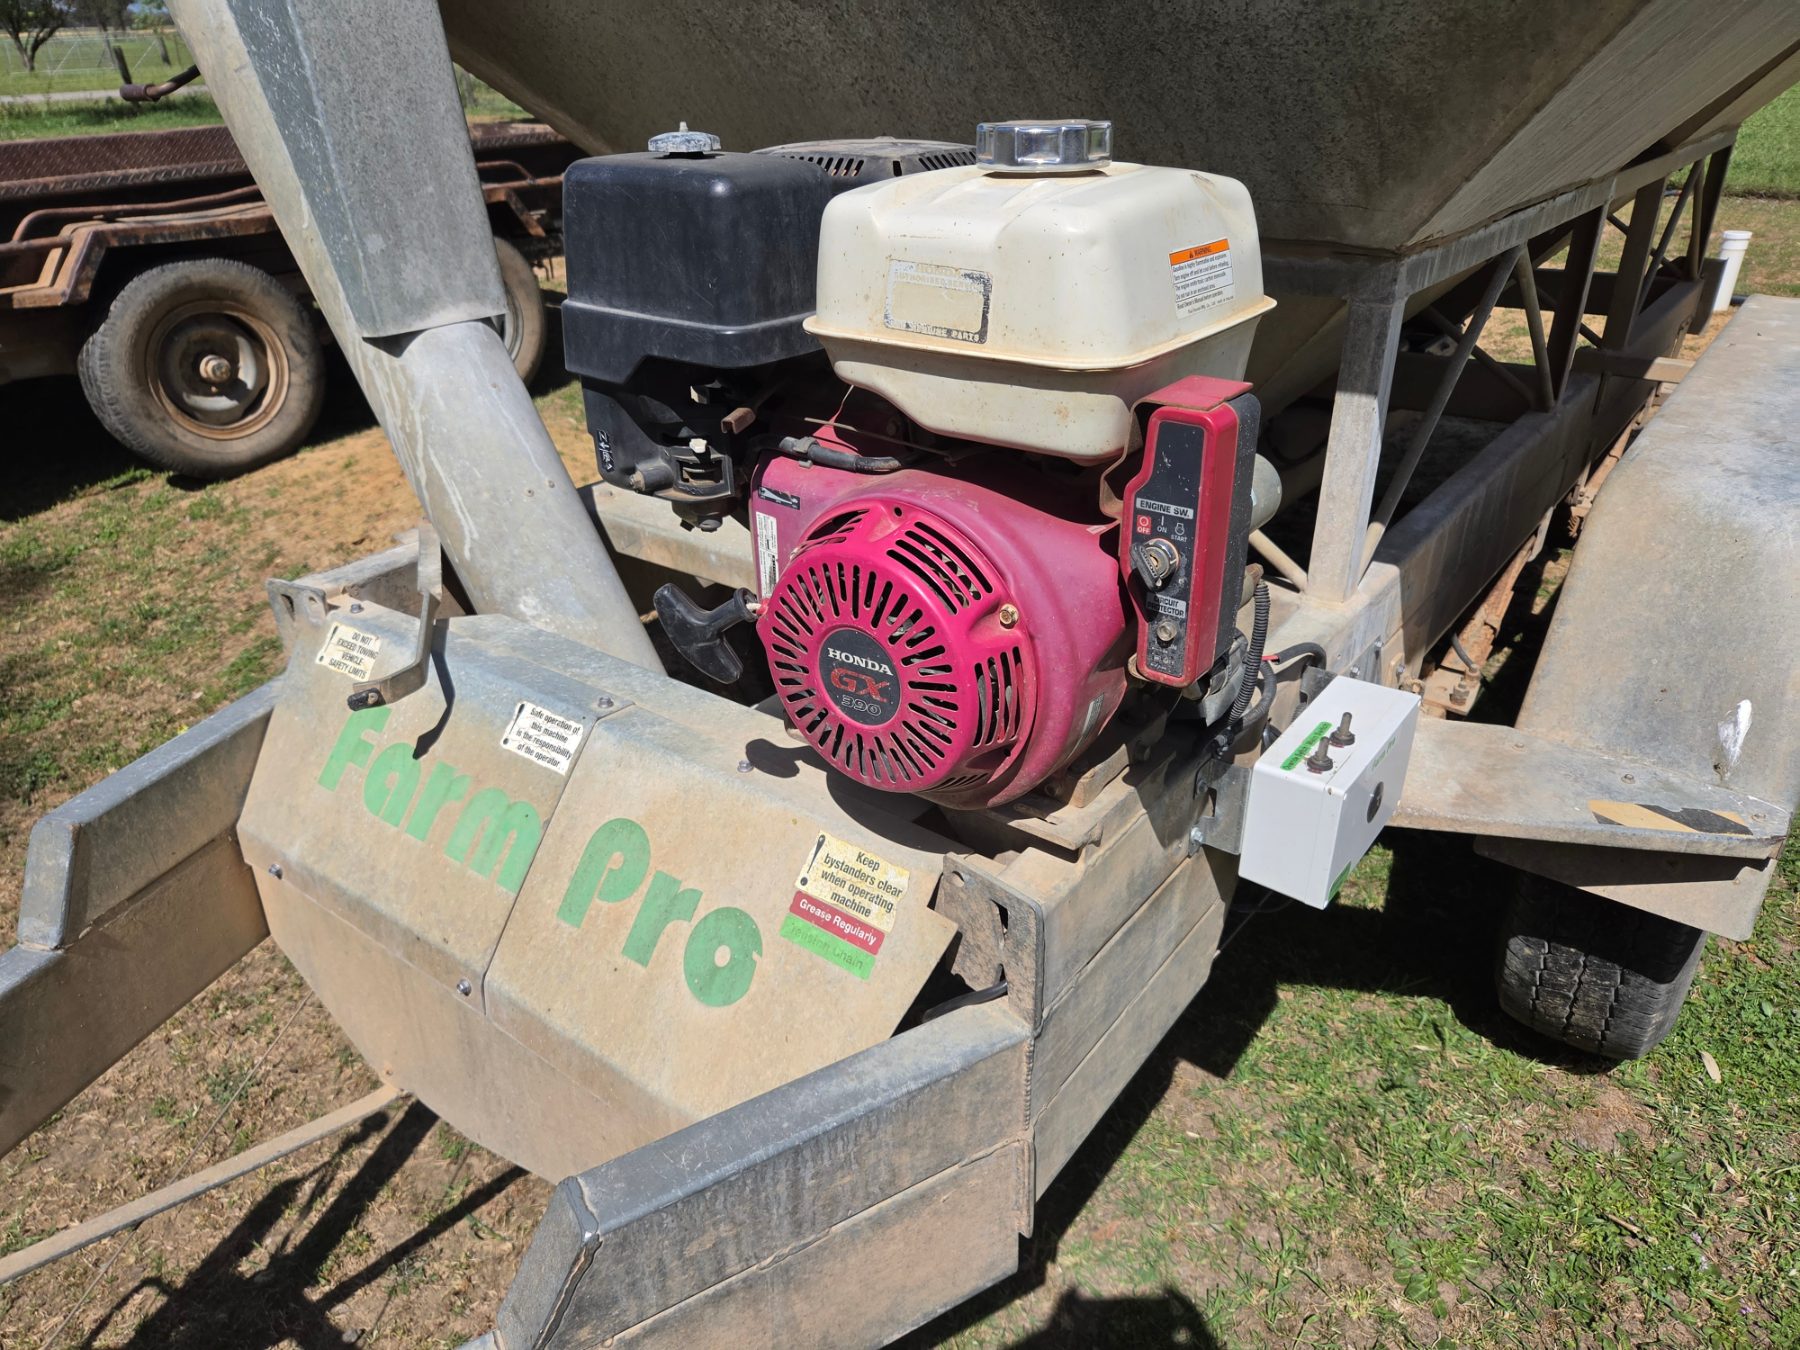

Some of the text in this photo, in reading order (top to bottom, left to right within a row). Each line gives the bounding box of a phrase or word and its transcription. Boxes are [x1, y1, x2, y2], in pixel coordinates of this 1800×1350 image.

[1140, 500, 1190, 517] ENGINE SW.
[1137, 526, 1151, 534] OFF
[337, 638, 357, 652] EXCEED
[352, 632, 373, 646] DO NOT
[329, 658, 367, 679] SAFETY LIMITS
[342, 652, 363, 665] VEHICLE
[827, 648, 894, 676] HONDA
[831, 667, 890, 703] GX
[842, 694, 881, 716] 390
[530, 708, 581, 735] Safe operation of
[531, 722, 568, 743] this machine
[516, 729, 572, 761] is the responsibility
[517, 743, 524, 751] of
[524, 746, 534, 756] the
[318, 706, 763, 1007] Farm Pro
[856, 851, 880, 871] Keep
[824, 853, 903, 898] bystanders clear
[821, 869, 894, 913] when operating
[830, 891, 872, 918] machine
[799, 898, 877, 946] Grease Regularly
